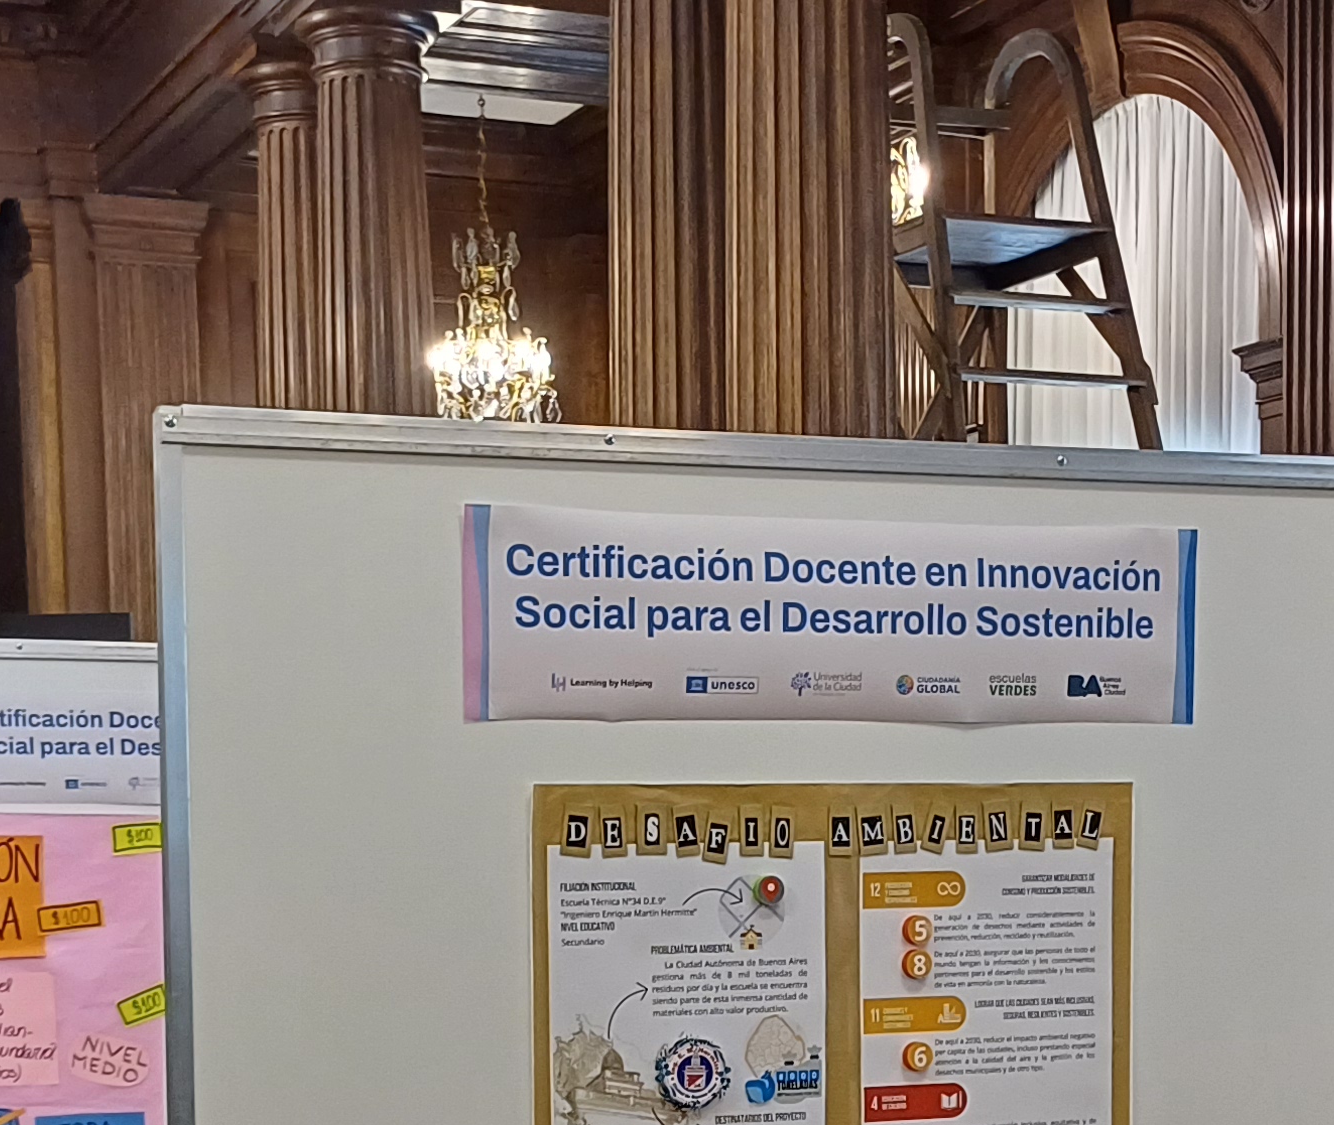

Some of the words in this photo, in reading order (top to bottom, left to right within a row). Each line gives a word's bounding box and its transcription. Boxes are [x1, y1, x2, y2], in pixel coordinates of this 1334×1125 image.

[506, 543, 753, 581] Certificación
[764, 551, 917, 587] Docente
[925, 562, 967, 587] en
[977, 558, 1160, 591] Innovación
[515, 596, 635, 629] Social
[647, 605, 731, 638] para
[740, 600, 770, 633] el
[782, 601, 967, 636] Desarrollo
[976, 606, 1154, 639] Sostenible
[814, 672, 862, 682] Universidad
[989, 674, 1036, 684] escuelas
[570, 679, 607, 688] Learning
[609, 679, 619, 688] by
[620, 679, 652, 689] Helping
[711, 680, 755, 690] unesco
[813, 682, 823, 691] de
[825, 682, 831, 691] la
[833, 682, 862, 692] Ciudad
[918, 684, 961, 694] GLOBAL
[989, 685, 1037, 696] VERDES
[41, 741, 91, 759] para
[96, 738, 114, 755] el
[870, 882, 880, 897] 12
[561, 899, 589, 907] Escuela
[591, 898, 620, 906] Técnica
[602, 910, 632, 919] Enrique
[561, 923, 578, 932] NIVEL
[580, 922, 615, 931] EDUCATIVO
[915, 921, 927, 941] 5
[562, 938, 604, 946] Secundario
[914, 955, 926, 976] 8
[82, 1035, 147, 1067] NIVEL
[914, 1047, 927, 1068] 6
[72, 1053, 138, 1082] MEDIO
[871, 1096, 878, 1111] 4
